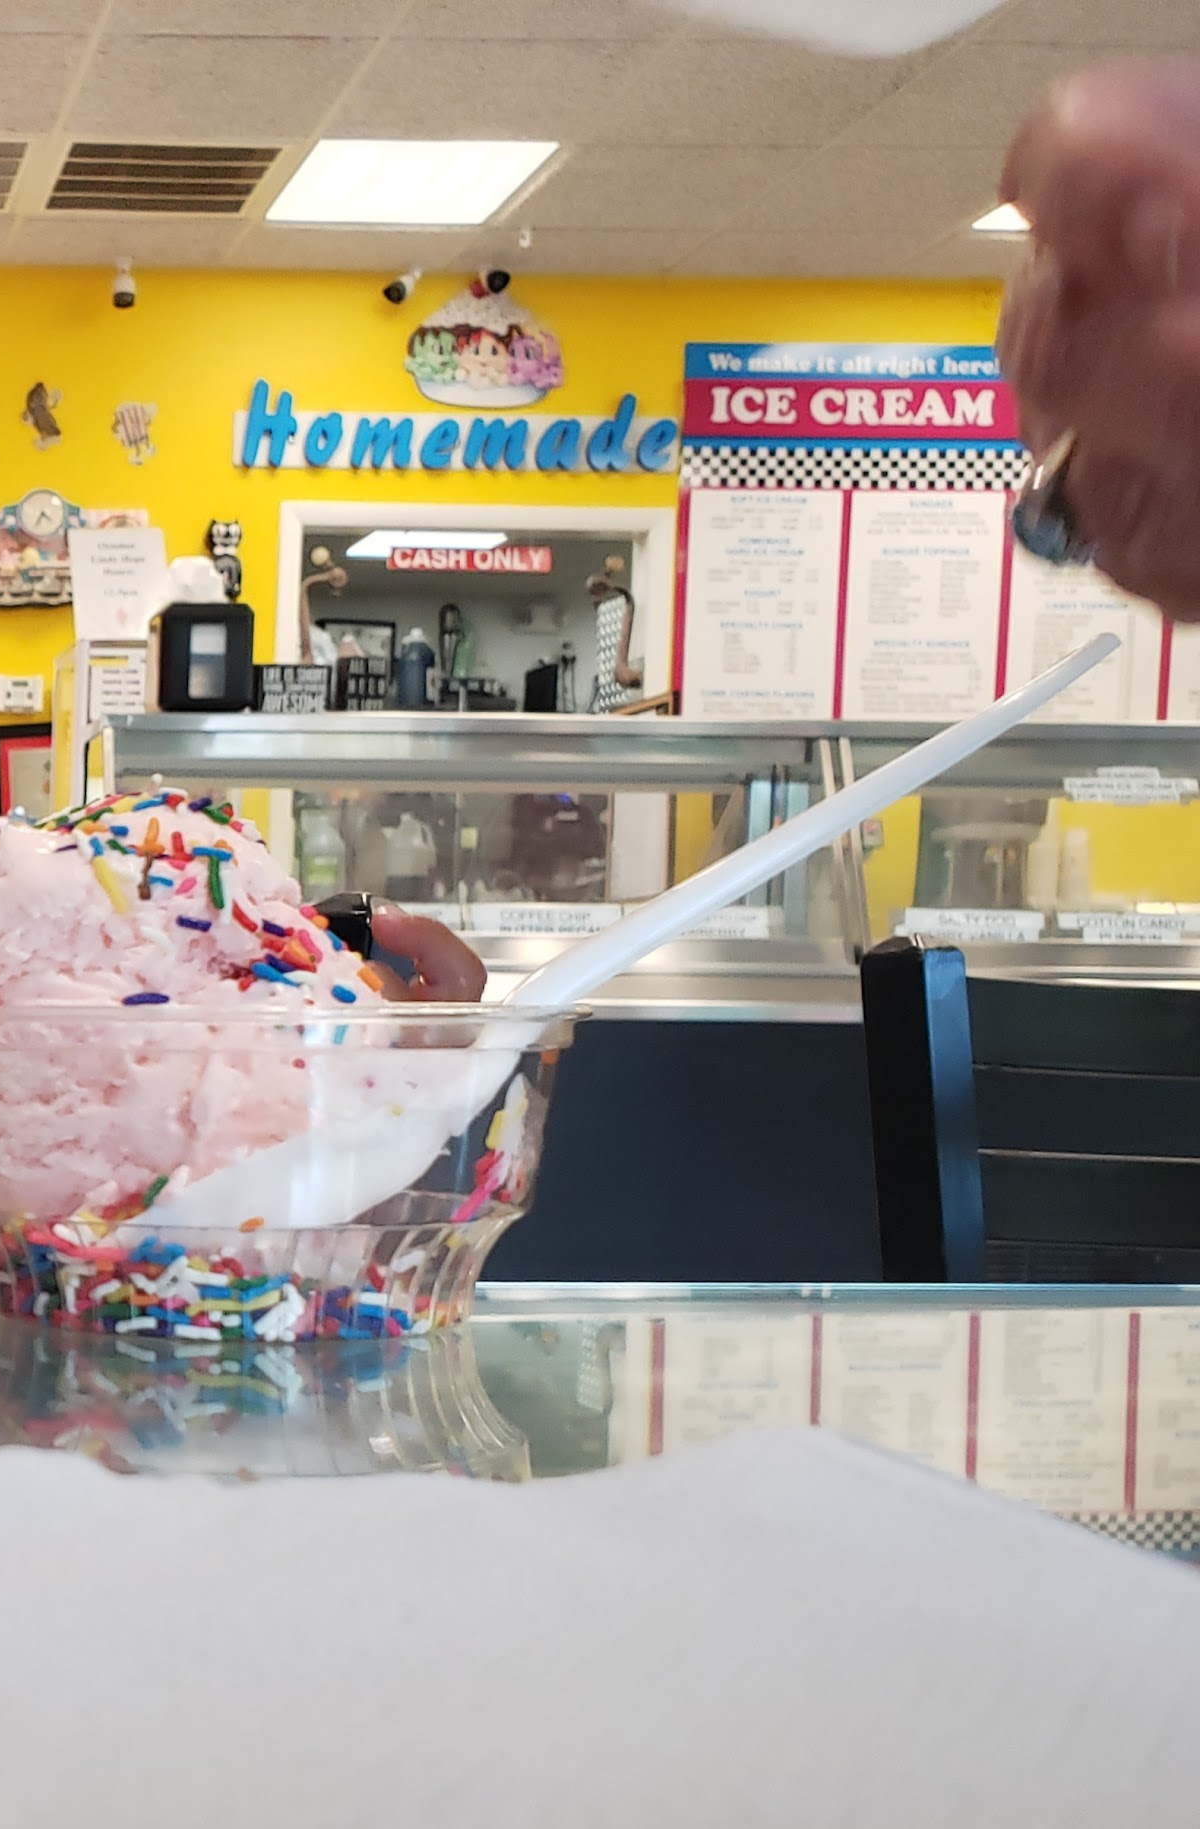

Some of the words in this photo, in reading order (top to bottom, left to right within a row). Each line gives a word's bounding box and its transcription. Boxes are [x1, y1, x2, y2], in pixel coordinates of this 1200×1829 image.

[708, 353, 741, 372] We
[748, 353, 811, 373] make
[816, 353, 836, 373] it
[842, 354, 874, 374] all
[878, 355, 938, 378] right
[944, 355, 1000, 376] here!
[710, 386, 798, 425] ICE
[809, 387, 997, 428] CREAM
[241, 377, 678, 471] Homemade
[393, 547, 467, 570] CASH
[473, 548, 545, 571] ONLY
[1077, 918, 1135, 930] COTTON
[1139, 918, 1187, 930] CANDY
